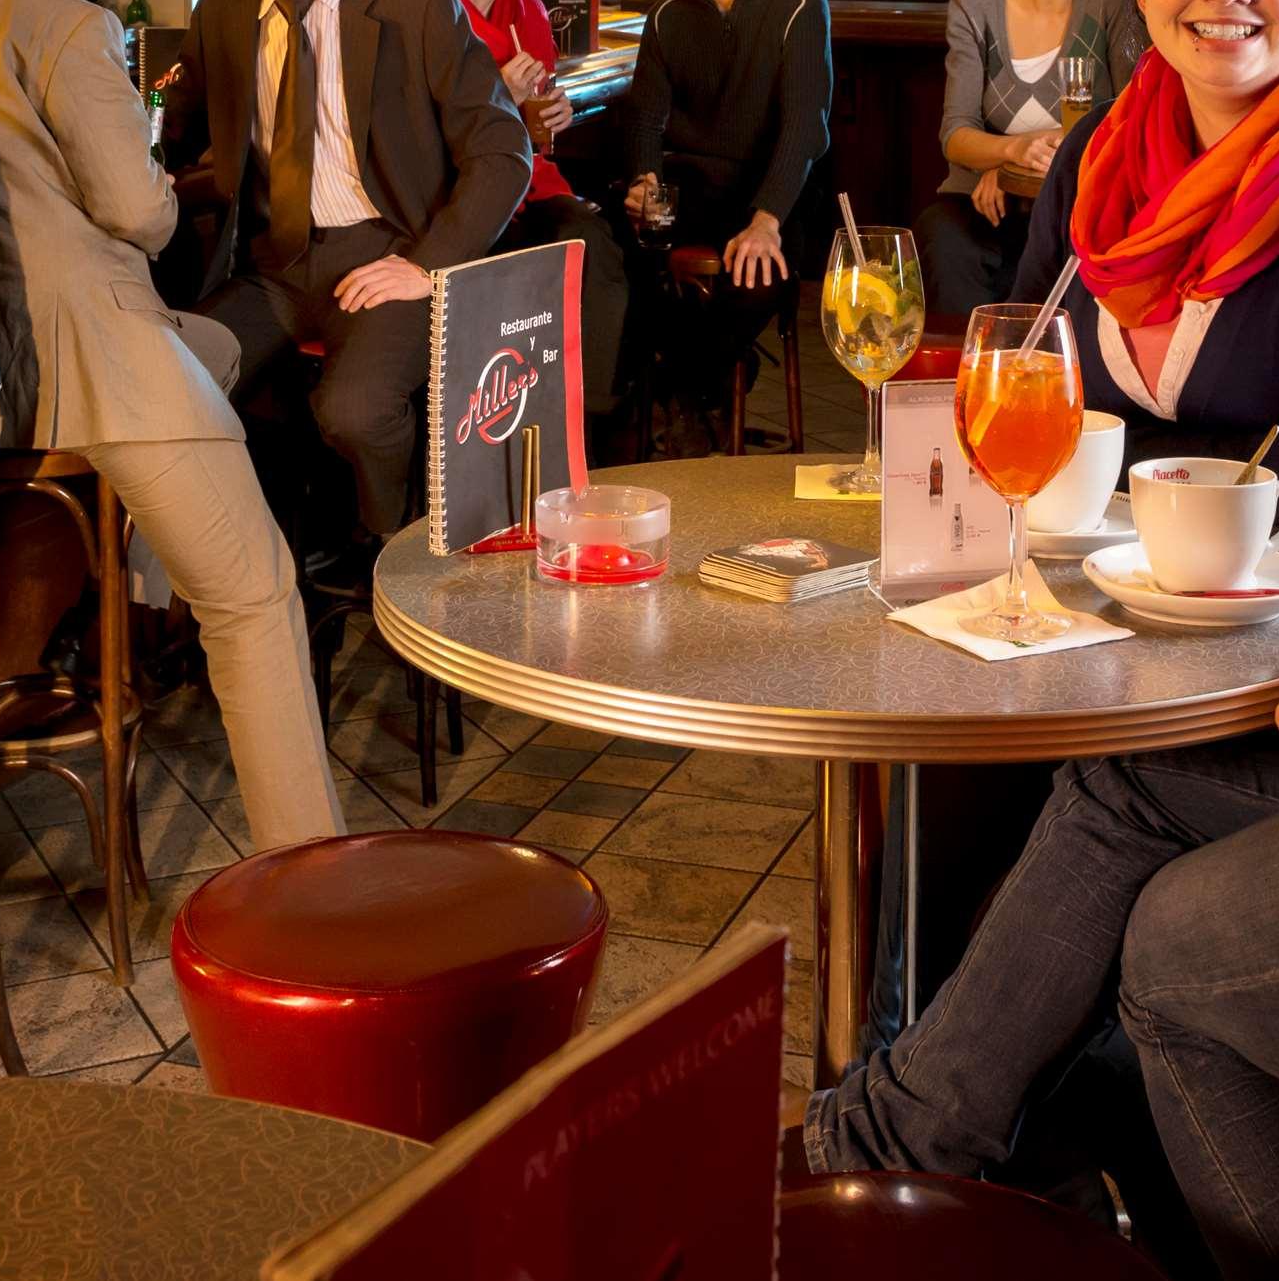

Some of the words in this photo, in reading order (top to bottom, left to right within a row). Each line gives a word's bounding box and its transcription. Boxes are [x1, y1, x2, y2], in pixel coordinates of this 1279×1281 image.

[501, 311, 552, 337] Restaurante
[529, 336, 536, 351] y
[543, 348, 559, 364] Bar
[1152, 468, 1191, 480] Piacetto
